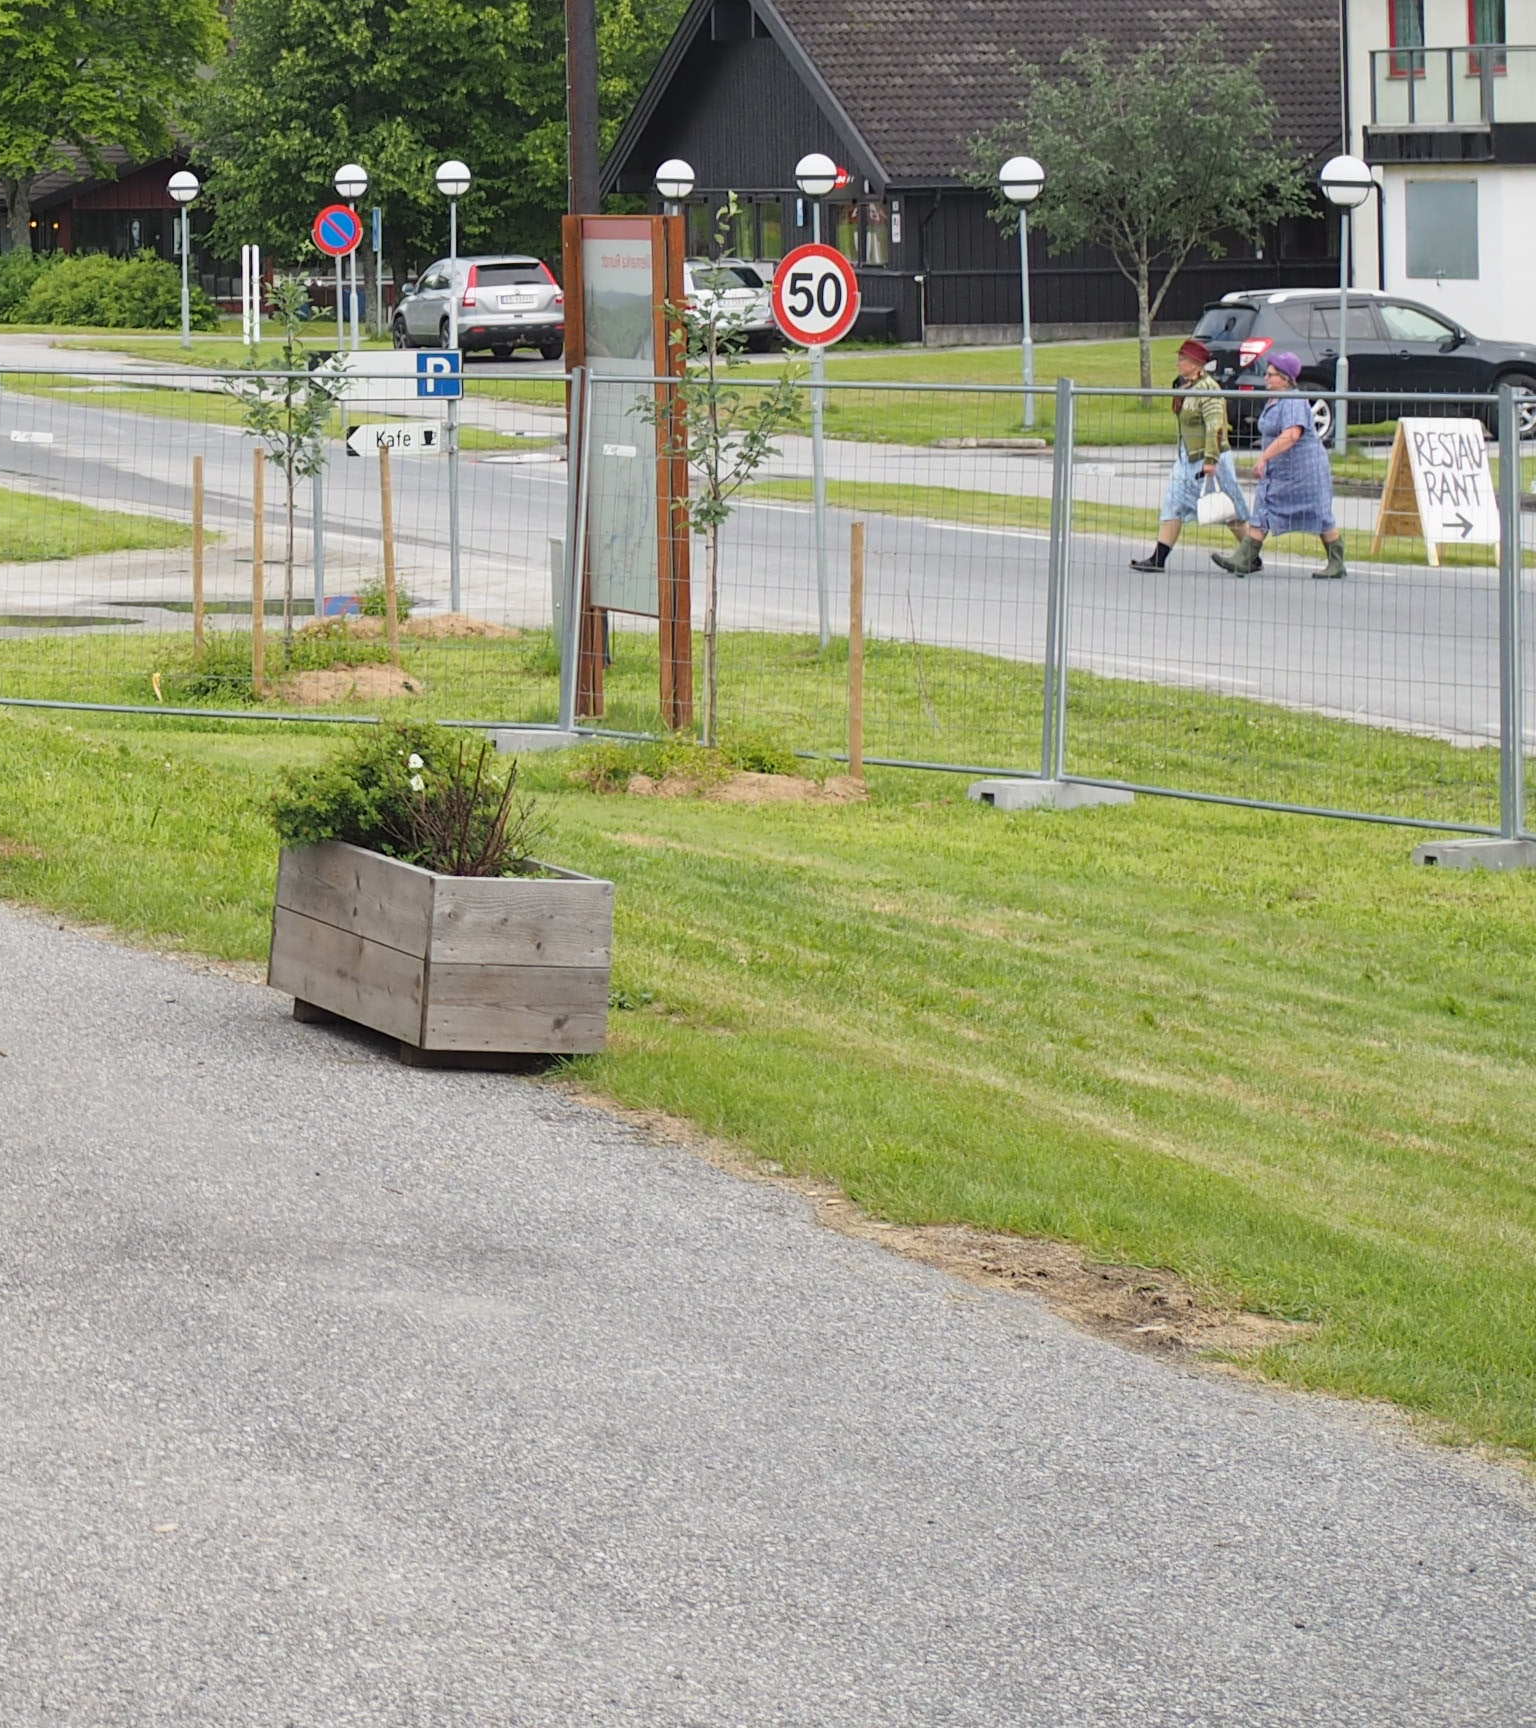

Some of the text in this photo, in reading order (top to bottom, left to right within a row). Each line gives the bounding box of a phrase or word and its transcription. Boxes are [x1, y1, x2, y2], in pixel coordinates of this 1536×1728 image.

[788, 272, 842, 318] 50
[426, 357, 451, 392] P
[376, 429, 412, 448] Kafe
[1423, 471, 1480, 507] RANT
